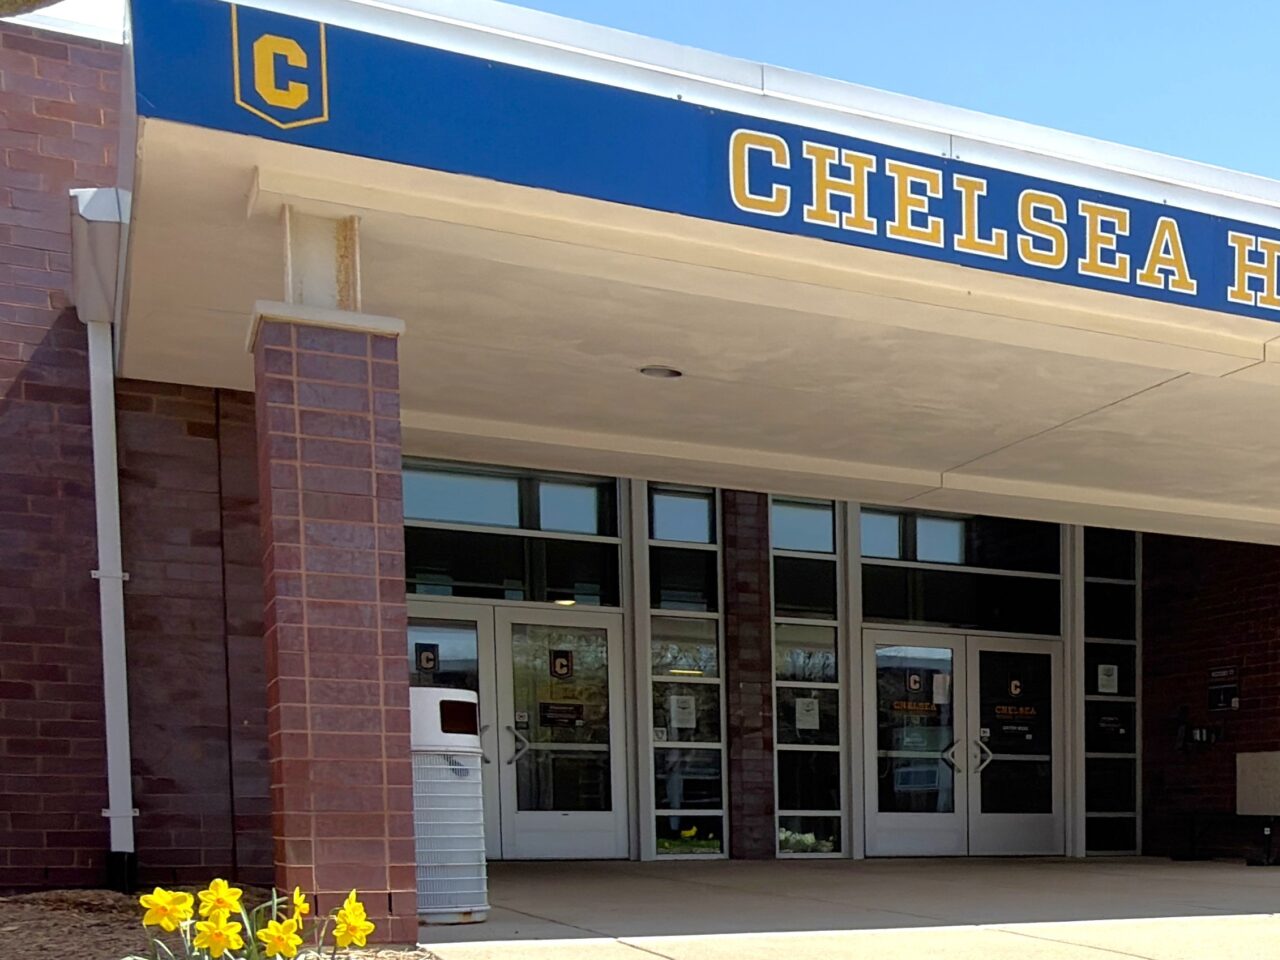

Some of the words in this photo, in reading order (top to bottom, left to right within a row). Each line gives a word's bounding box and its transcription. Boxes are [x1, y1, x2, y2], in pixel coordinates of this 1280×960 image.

[252, 33, 309, 110] C
[728, 128, 1198, 296] CHELSEA
[421, 652, 435, 668] C
[555, 658, 568, 674] C
[910, 675, 921, 690] C
[1010, 680, 1022, 694] C
[893, 701, 937, 711] CHELSEA
[995, 705, 1037, 715] CHELSEA
